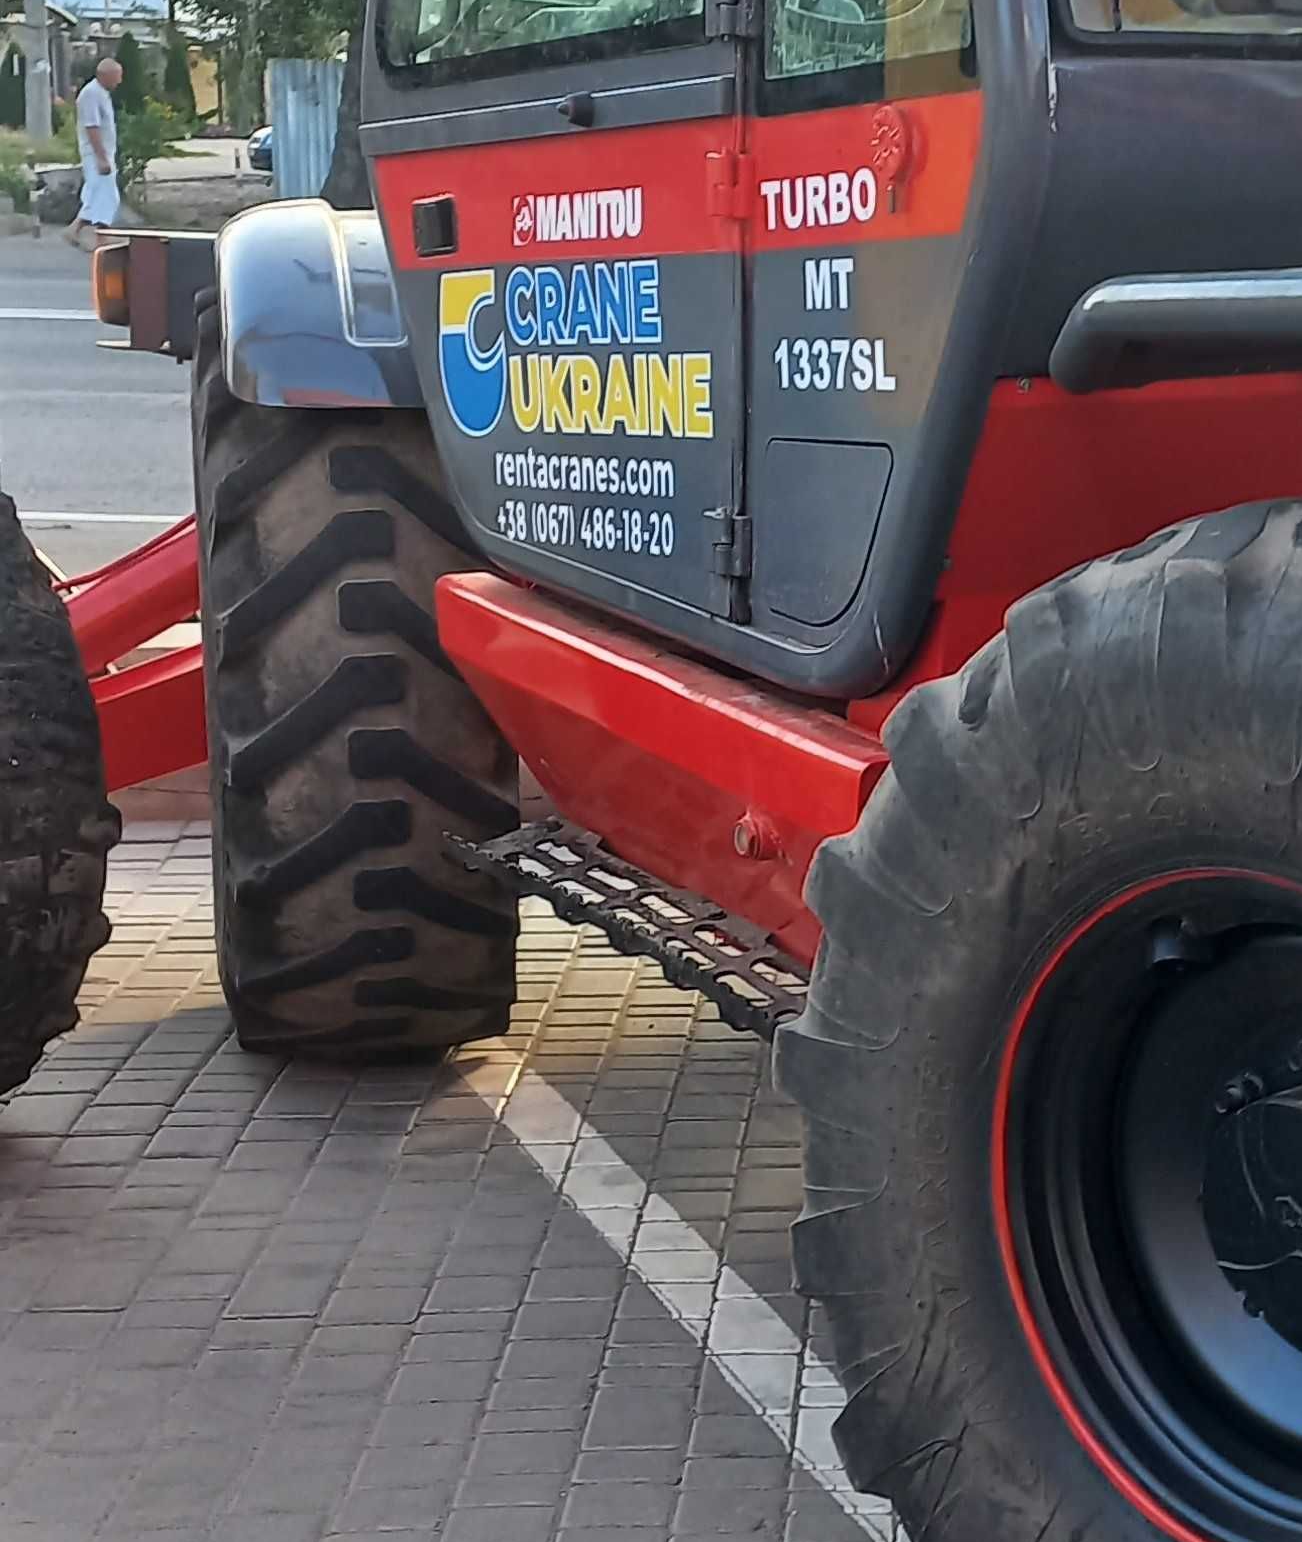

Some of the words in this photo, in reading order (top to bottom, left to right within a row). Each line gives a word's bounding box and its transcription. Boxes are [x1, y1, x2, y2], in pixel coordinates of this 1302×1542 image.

[535, 186, 642, 242] MANITOU
[760, 167, 877, 230] TURBO
[505, 259, 662, 346] CRANE
[804, 258, 854, 310] MT
[774, 338, 897, 391] 1337SL
[509, 352, 713, 438] UKRAINE
[495, 446, 675, 498] rentacranes.com
[498, 500, 527, 540] +38
[531, 502, 575, 546] (067)
[580, 507, 674, 556] 486-18-20
